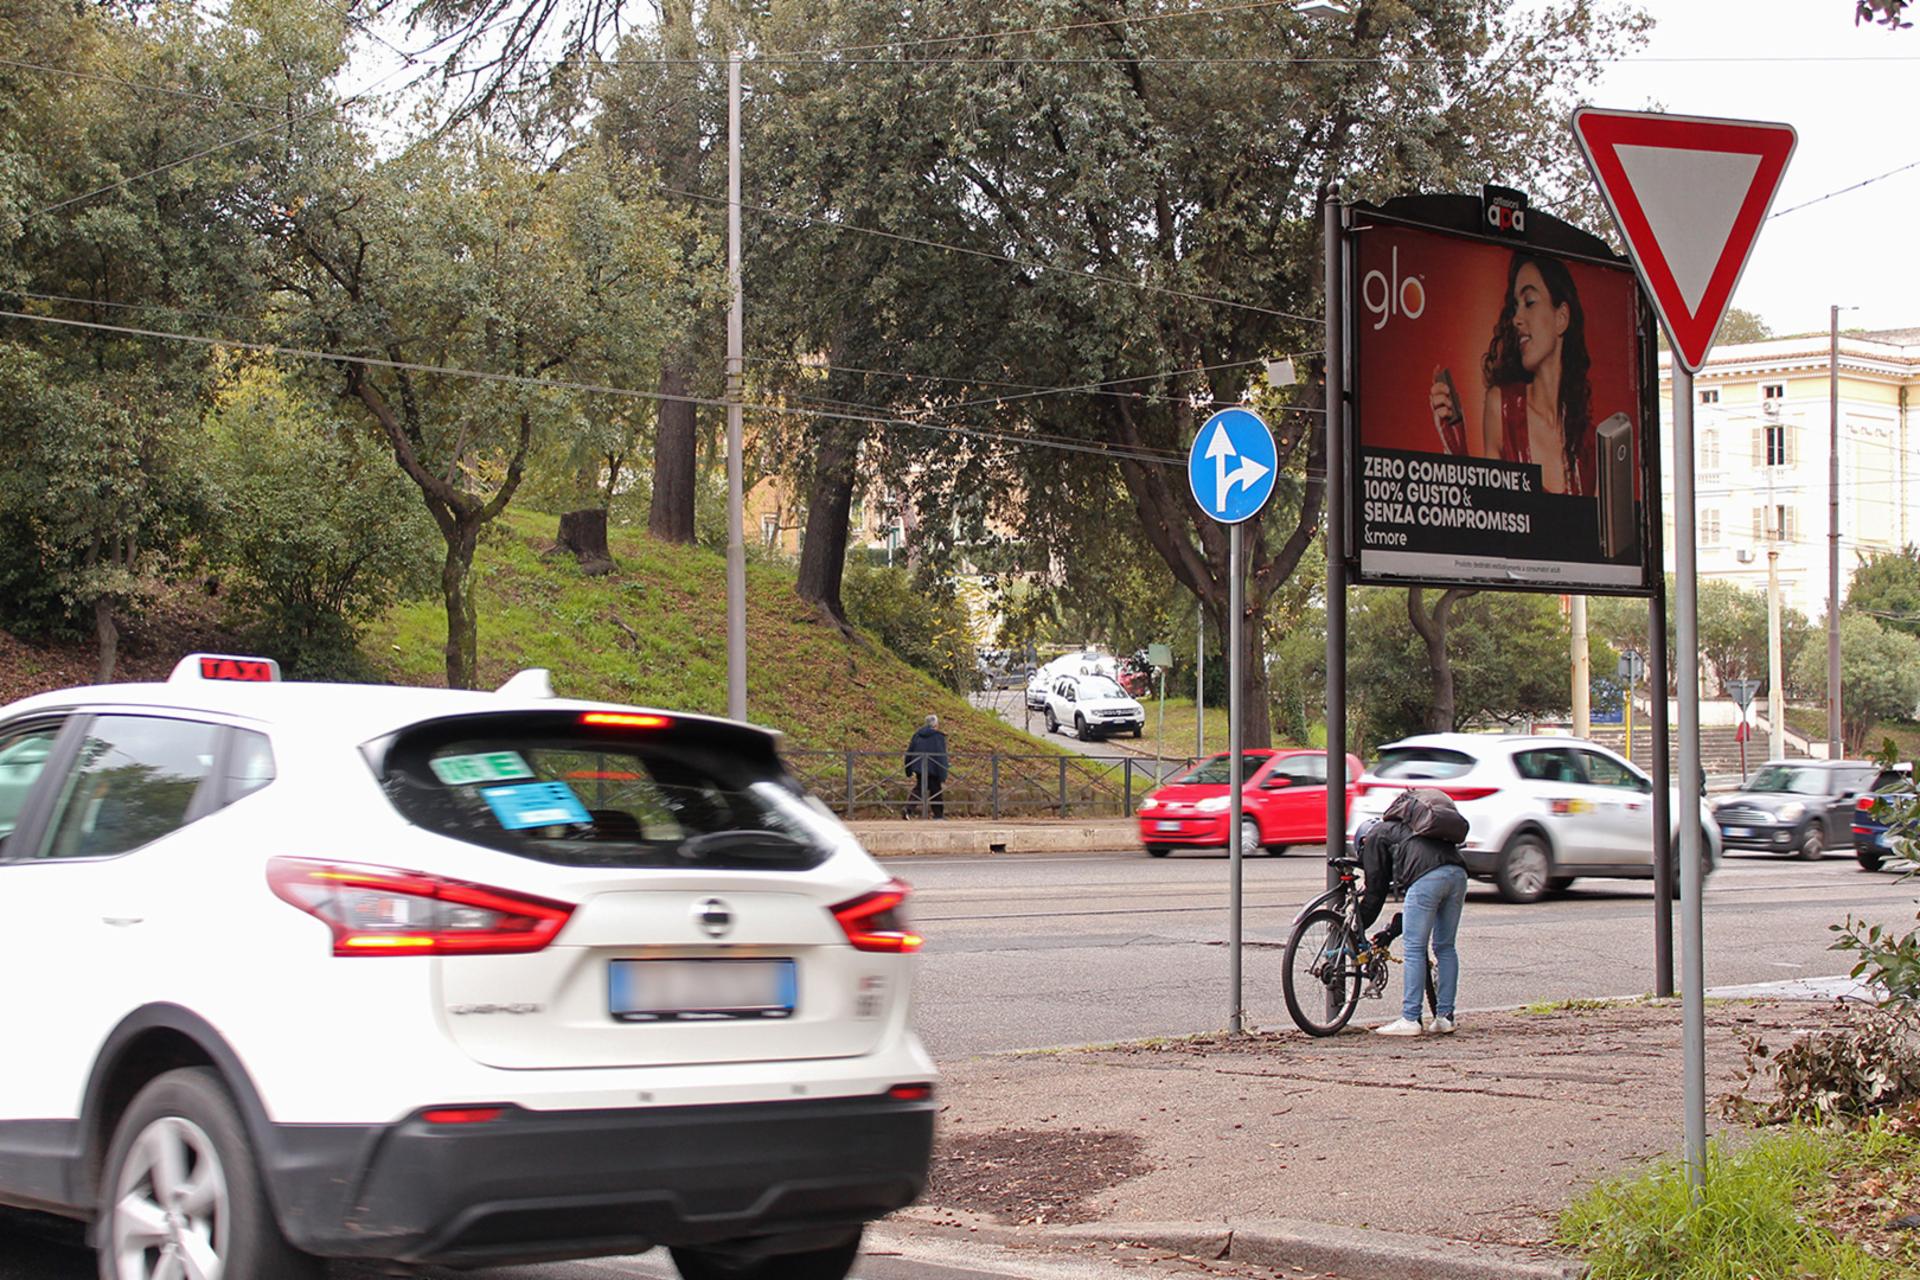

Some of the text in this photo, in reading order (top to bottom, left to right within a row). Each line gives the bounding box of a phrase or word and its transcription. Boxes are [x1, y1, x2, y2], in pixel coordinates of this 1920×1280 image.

[1487, 204, 1525, 232] apa
[1363, 456, 1405, 479] ZERO
[1522, 472, 1531, 492] &
[1364, 480, 1472, 507] 100% GUSTO &
[1364, 501, 1530, 533] SENZA COMPROMESSI
[1364, 523, 1408, 546] &more
[200, 658, 271, 682] TAXI
